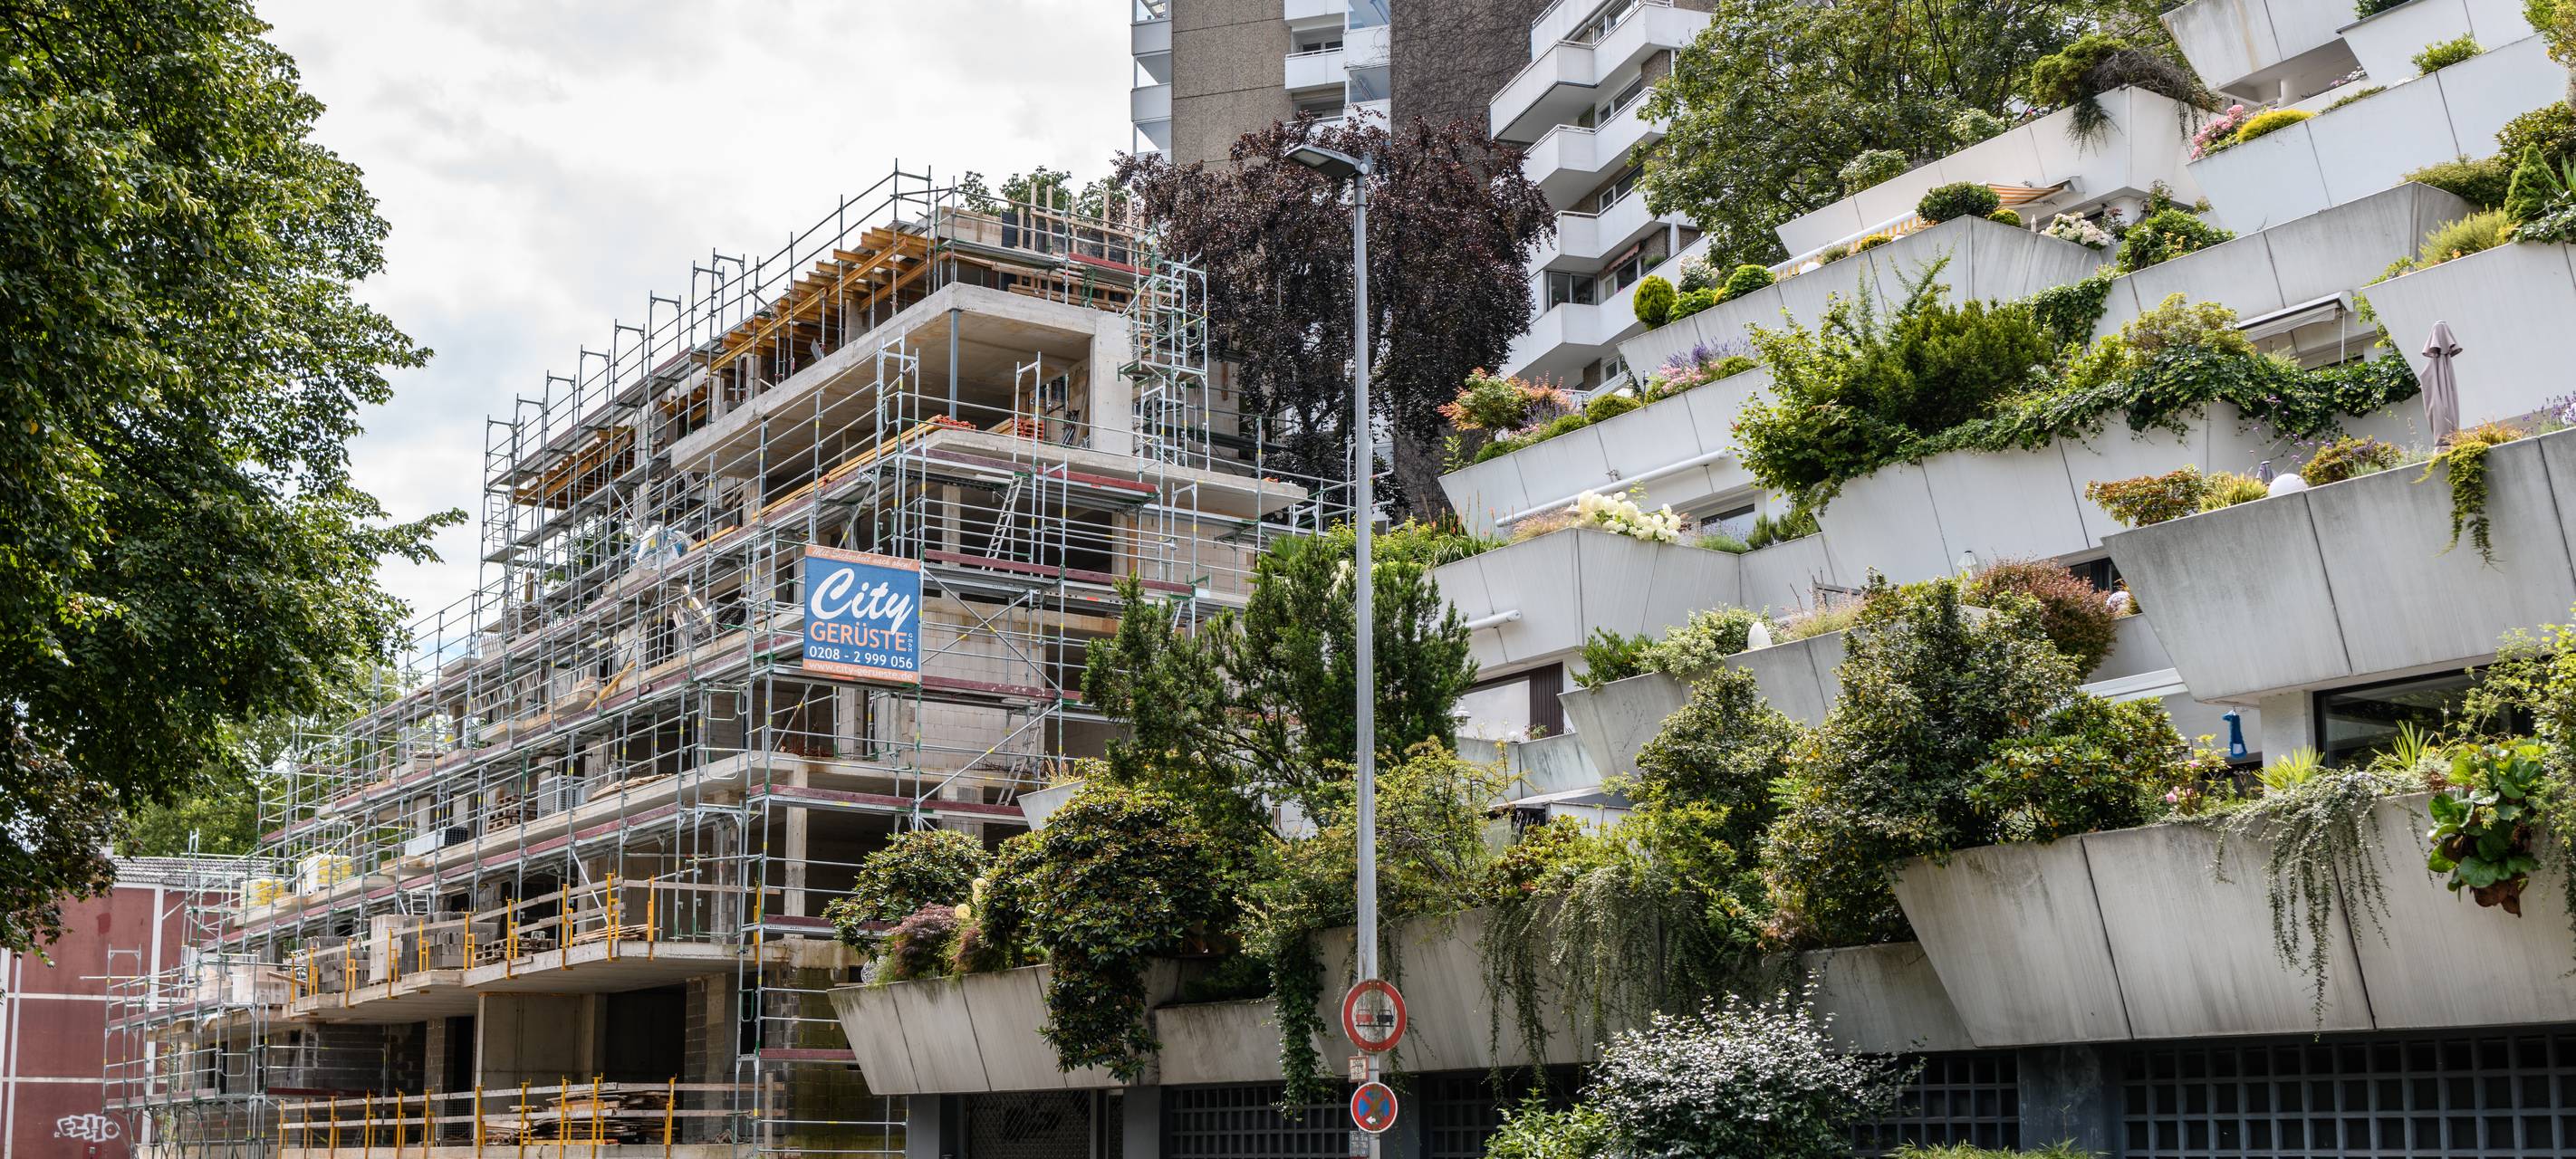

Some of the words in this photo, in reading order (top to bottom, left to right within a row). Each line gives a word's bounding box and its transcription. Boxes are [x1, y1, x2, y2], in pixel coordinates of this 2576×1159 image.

[811, 568, 914, 635] City
[811, 621, 908, 652] GERÜSTE
[809, 646, 840, 660] 0208
[853, 651, 860, 663] 2
[864, 652, 887, 666] 999
[890, 656, 913, 669] 056
[809, 662, 913, 681] www.city-gerueste.de
